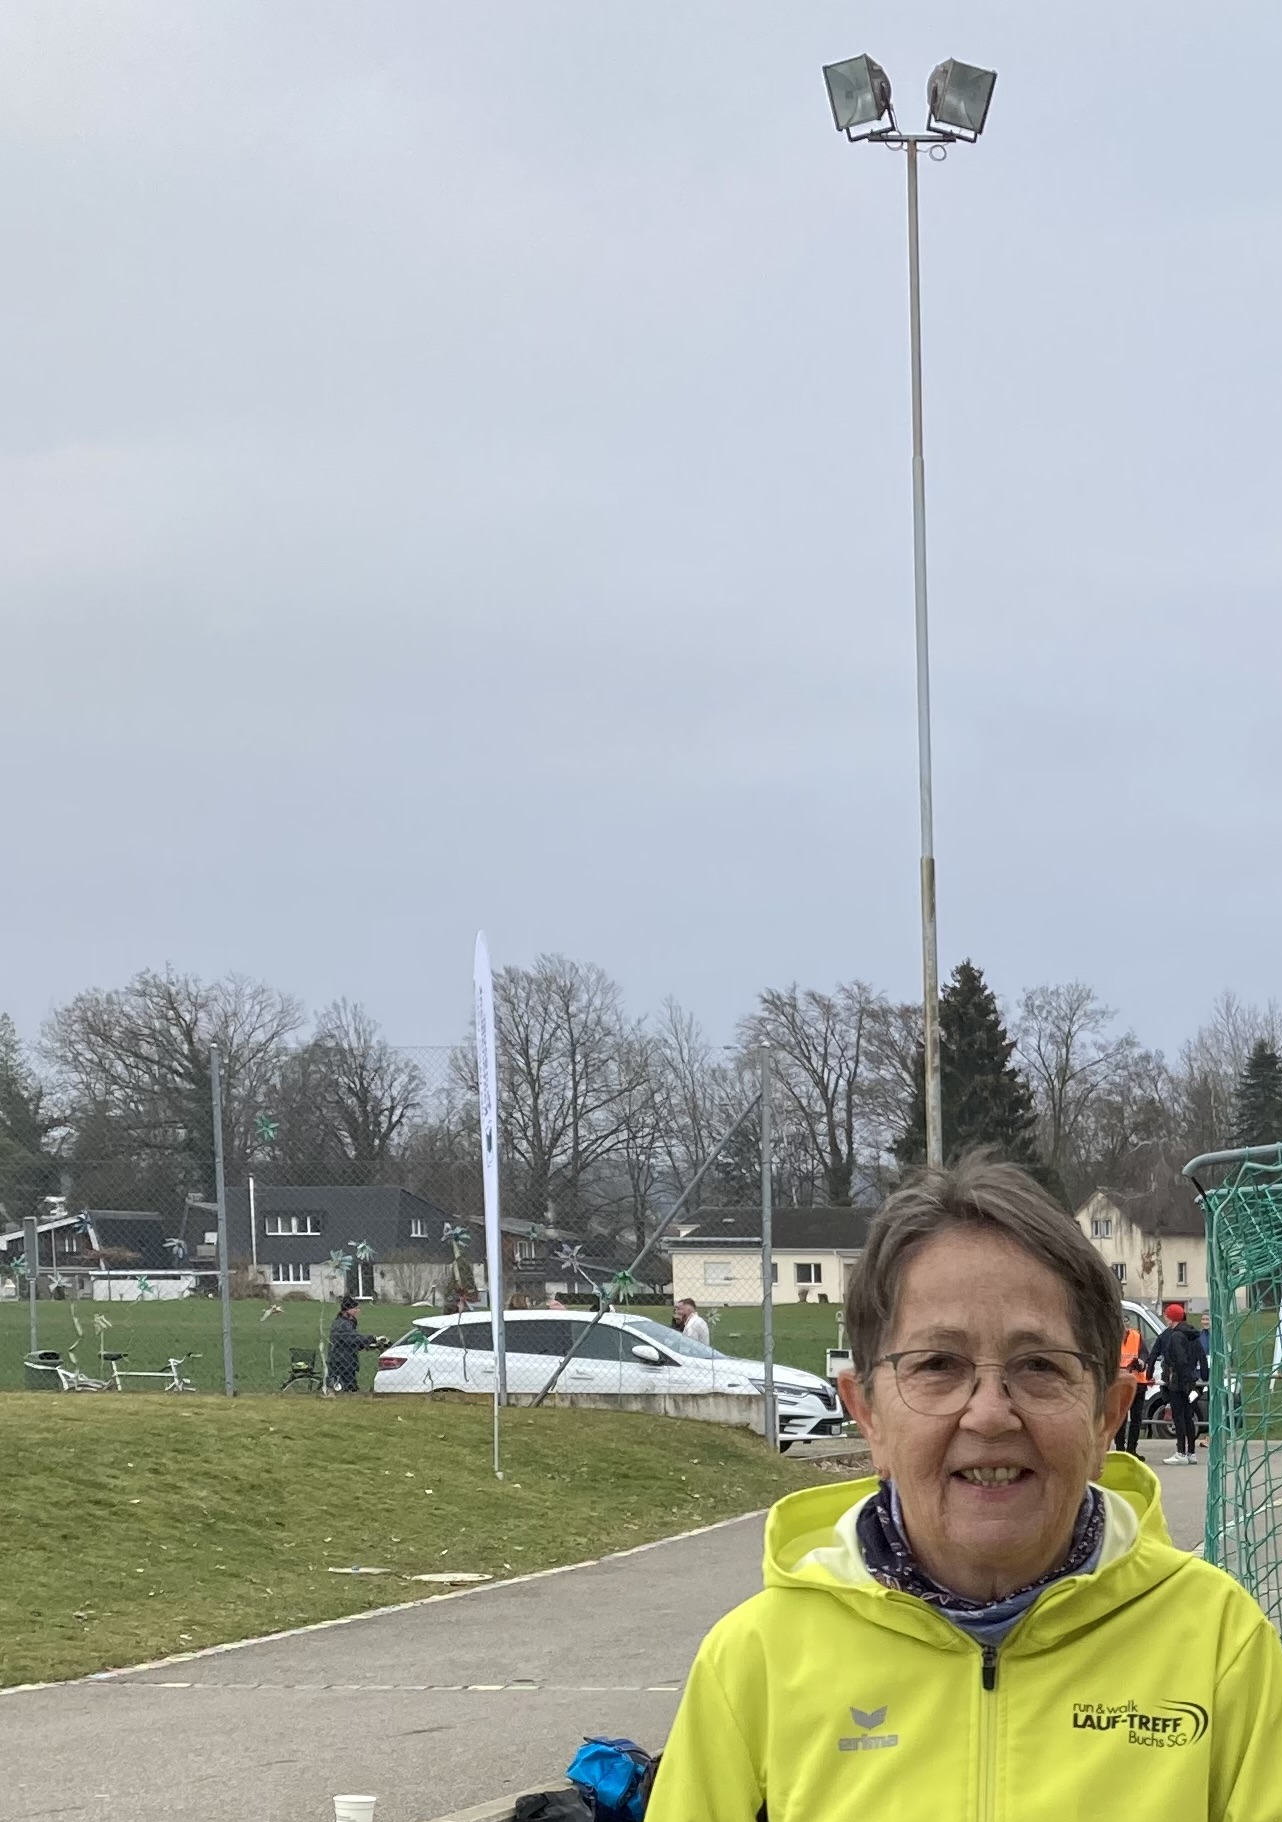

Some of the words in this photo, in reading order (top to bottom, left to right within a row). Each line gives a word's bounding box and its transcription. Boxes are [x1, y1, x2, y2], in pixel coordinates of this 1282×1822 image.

[1073, 1703, 1094, 1714] run
[1096, 1703, 1105, 1714] &
[1107, 1700, 1138, 1714] walk
[1073, 1713, 1183, 1732] LAUF-TREFF
[1128, 1730, 1164, 1747] Buchs
[1167, 1733, 1187, 1747] SG
